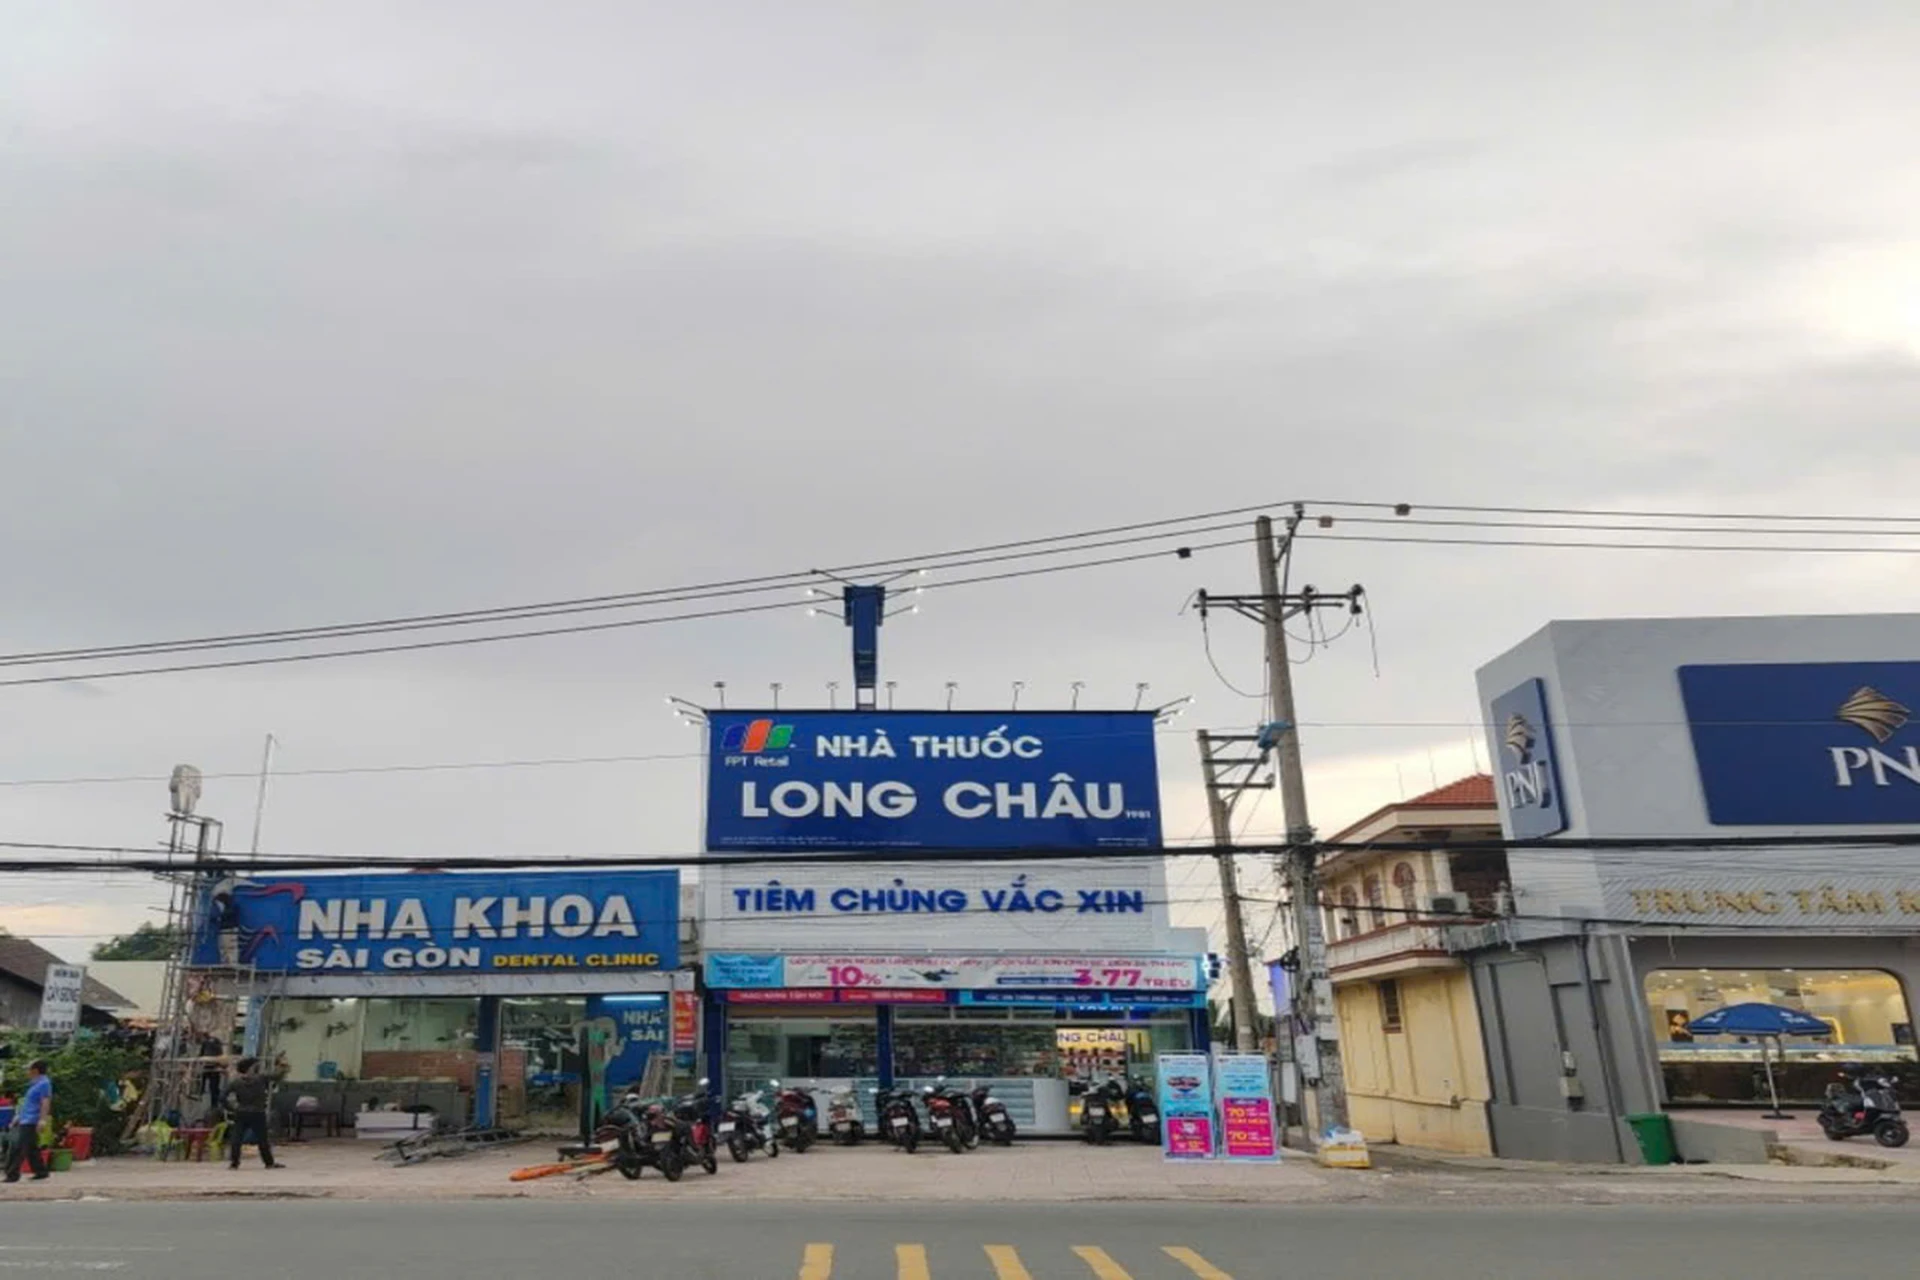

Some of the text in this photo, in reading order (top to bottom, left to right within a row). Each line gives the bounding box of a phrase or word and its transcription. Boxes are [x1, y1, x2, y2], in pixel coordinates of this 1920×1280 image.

[815, 725, 1044, 759] NHÀ THUỐC
[724, 755, 790, 768] FPT Retail
[742, 780, 918, 818] LONG
[942, 772, 1124, 819] CHÂU
[1505, 761, 1552, 809] PNJ
[733, 873, 1145, 914] TIÊM CHỦNG VẮC XIN
[1630, 888, 1781, 914] TRUNG
[298, 894, 640, 940] NHA KHOA
[296, 941, 660, 969] SÀI GÒN DENTAL CLINIC
[827, 966, 882, 987] 10%
[1074, 968, 1142, 987] 3.77
